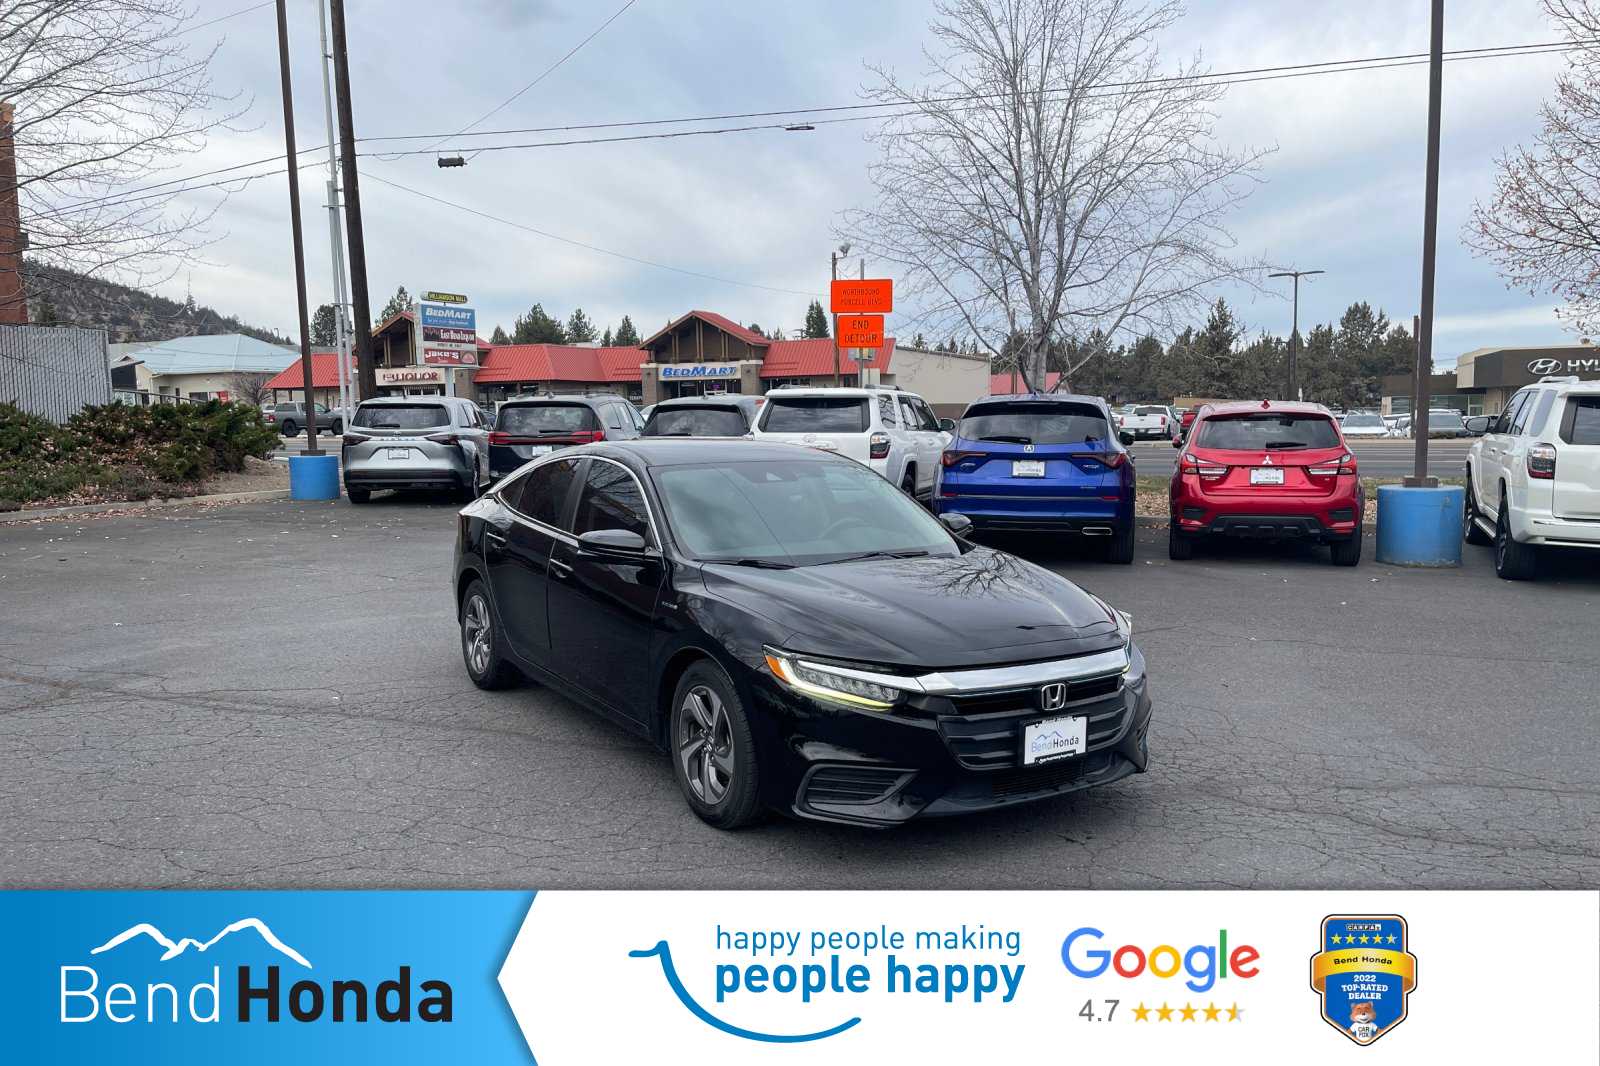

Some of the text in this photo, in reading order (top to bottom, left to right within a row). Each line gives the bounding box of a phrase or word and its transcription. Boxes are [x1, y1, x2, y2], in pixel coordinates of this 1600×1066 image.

[852, 320, 869, 330] END
[844, 333, 877, 344] DETOUR
[1053, 736, 1079, 748] Honda
